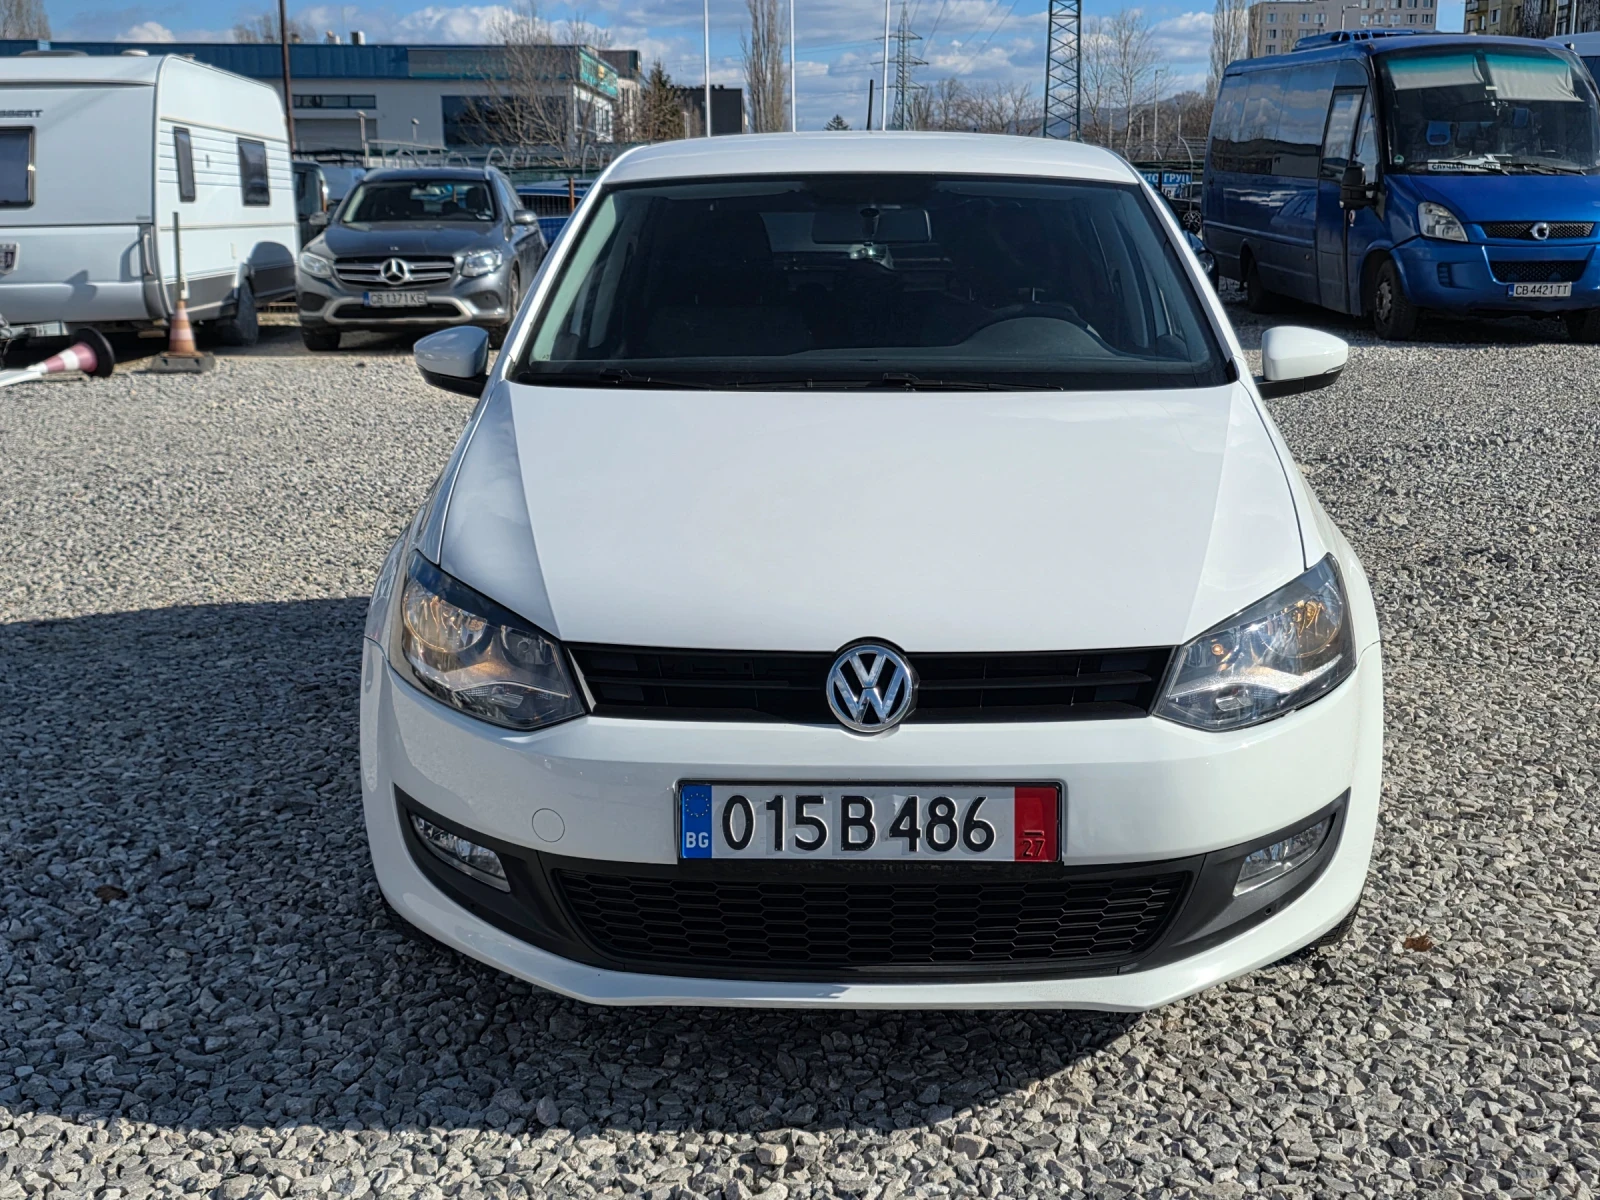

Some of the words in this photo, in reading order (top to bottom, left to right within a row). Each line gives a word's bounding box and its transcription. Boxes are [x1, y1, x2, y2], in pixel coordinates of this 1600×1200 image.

[1530, 284, 1554, 295] 4421
[685, 831, 710, 850] BG
[1021, 837, 1046, 857] 27
